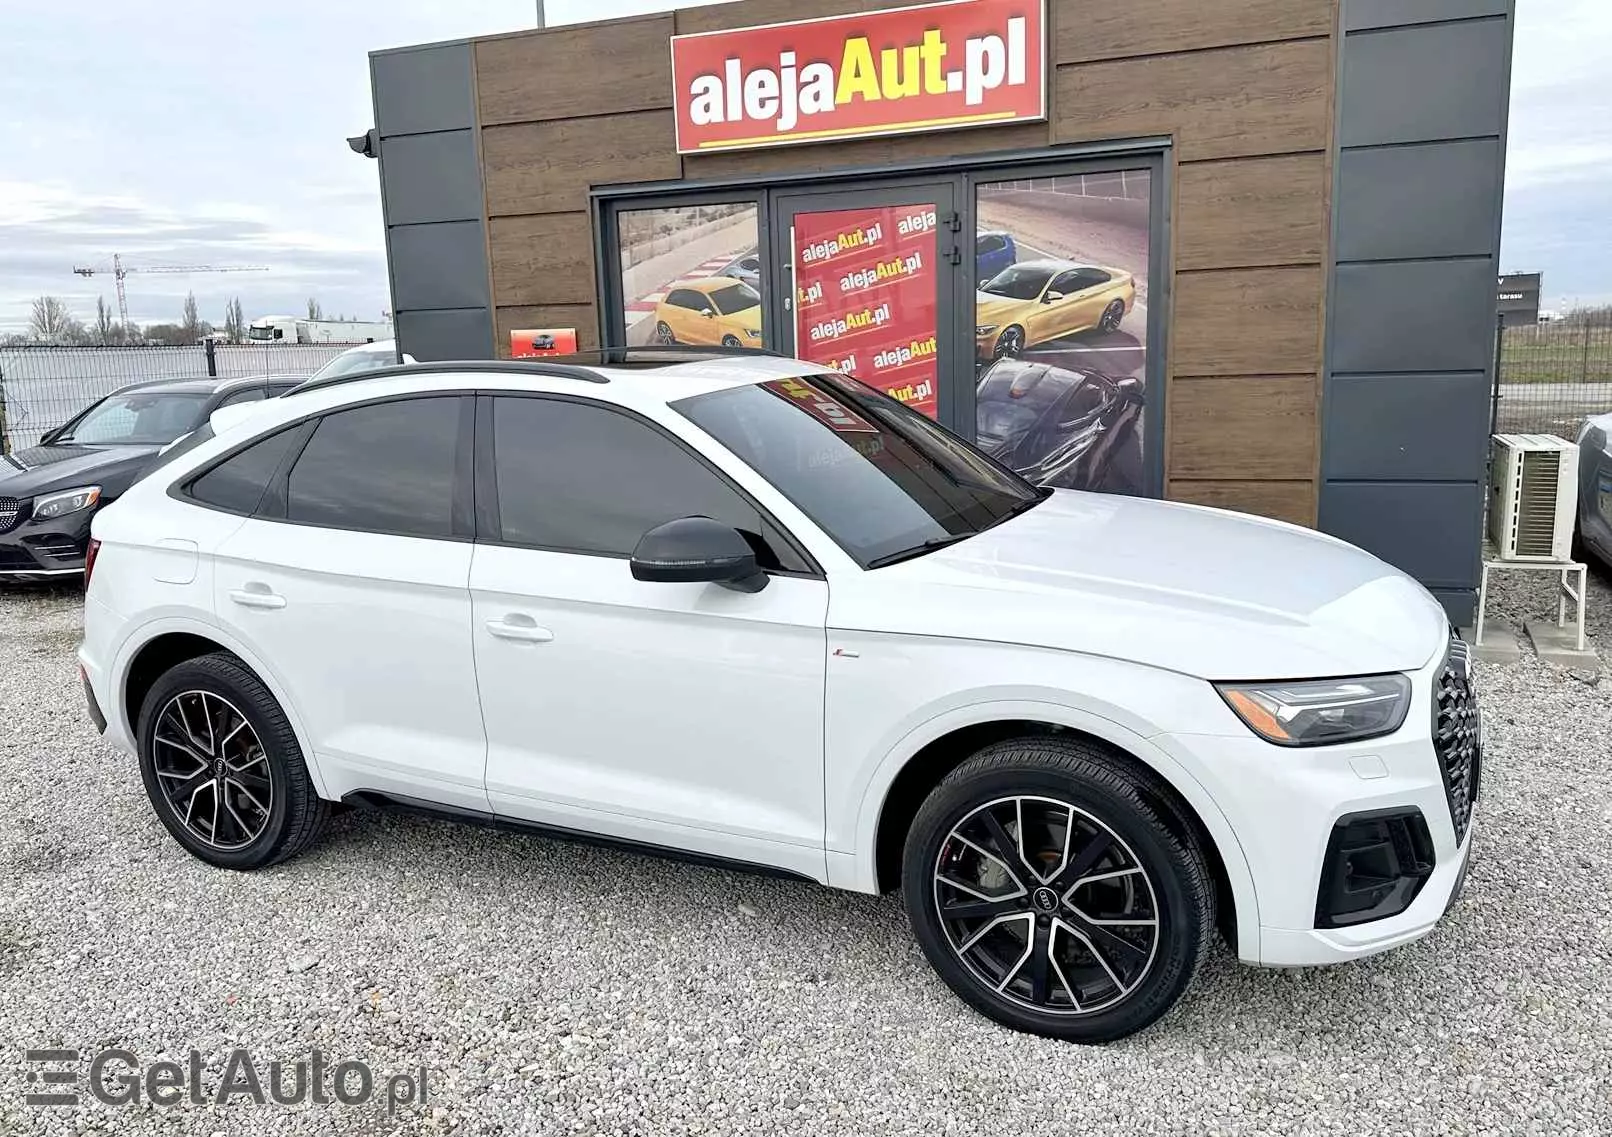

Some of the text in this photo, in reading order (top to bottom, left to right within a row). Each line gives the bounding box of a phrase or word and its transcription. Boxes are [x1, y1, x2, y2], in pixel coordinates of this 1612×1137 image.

[689, 17, 1026, 132] alejaAut.pl
[802, 223, 883, 263] alejaAut.pl
[839, 252, 922, 292] alejaAut.pl
[797, 281, 823, 304] t.pl
[810, 303, 890, 341] alejaAut.pl
